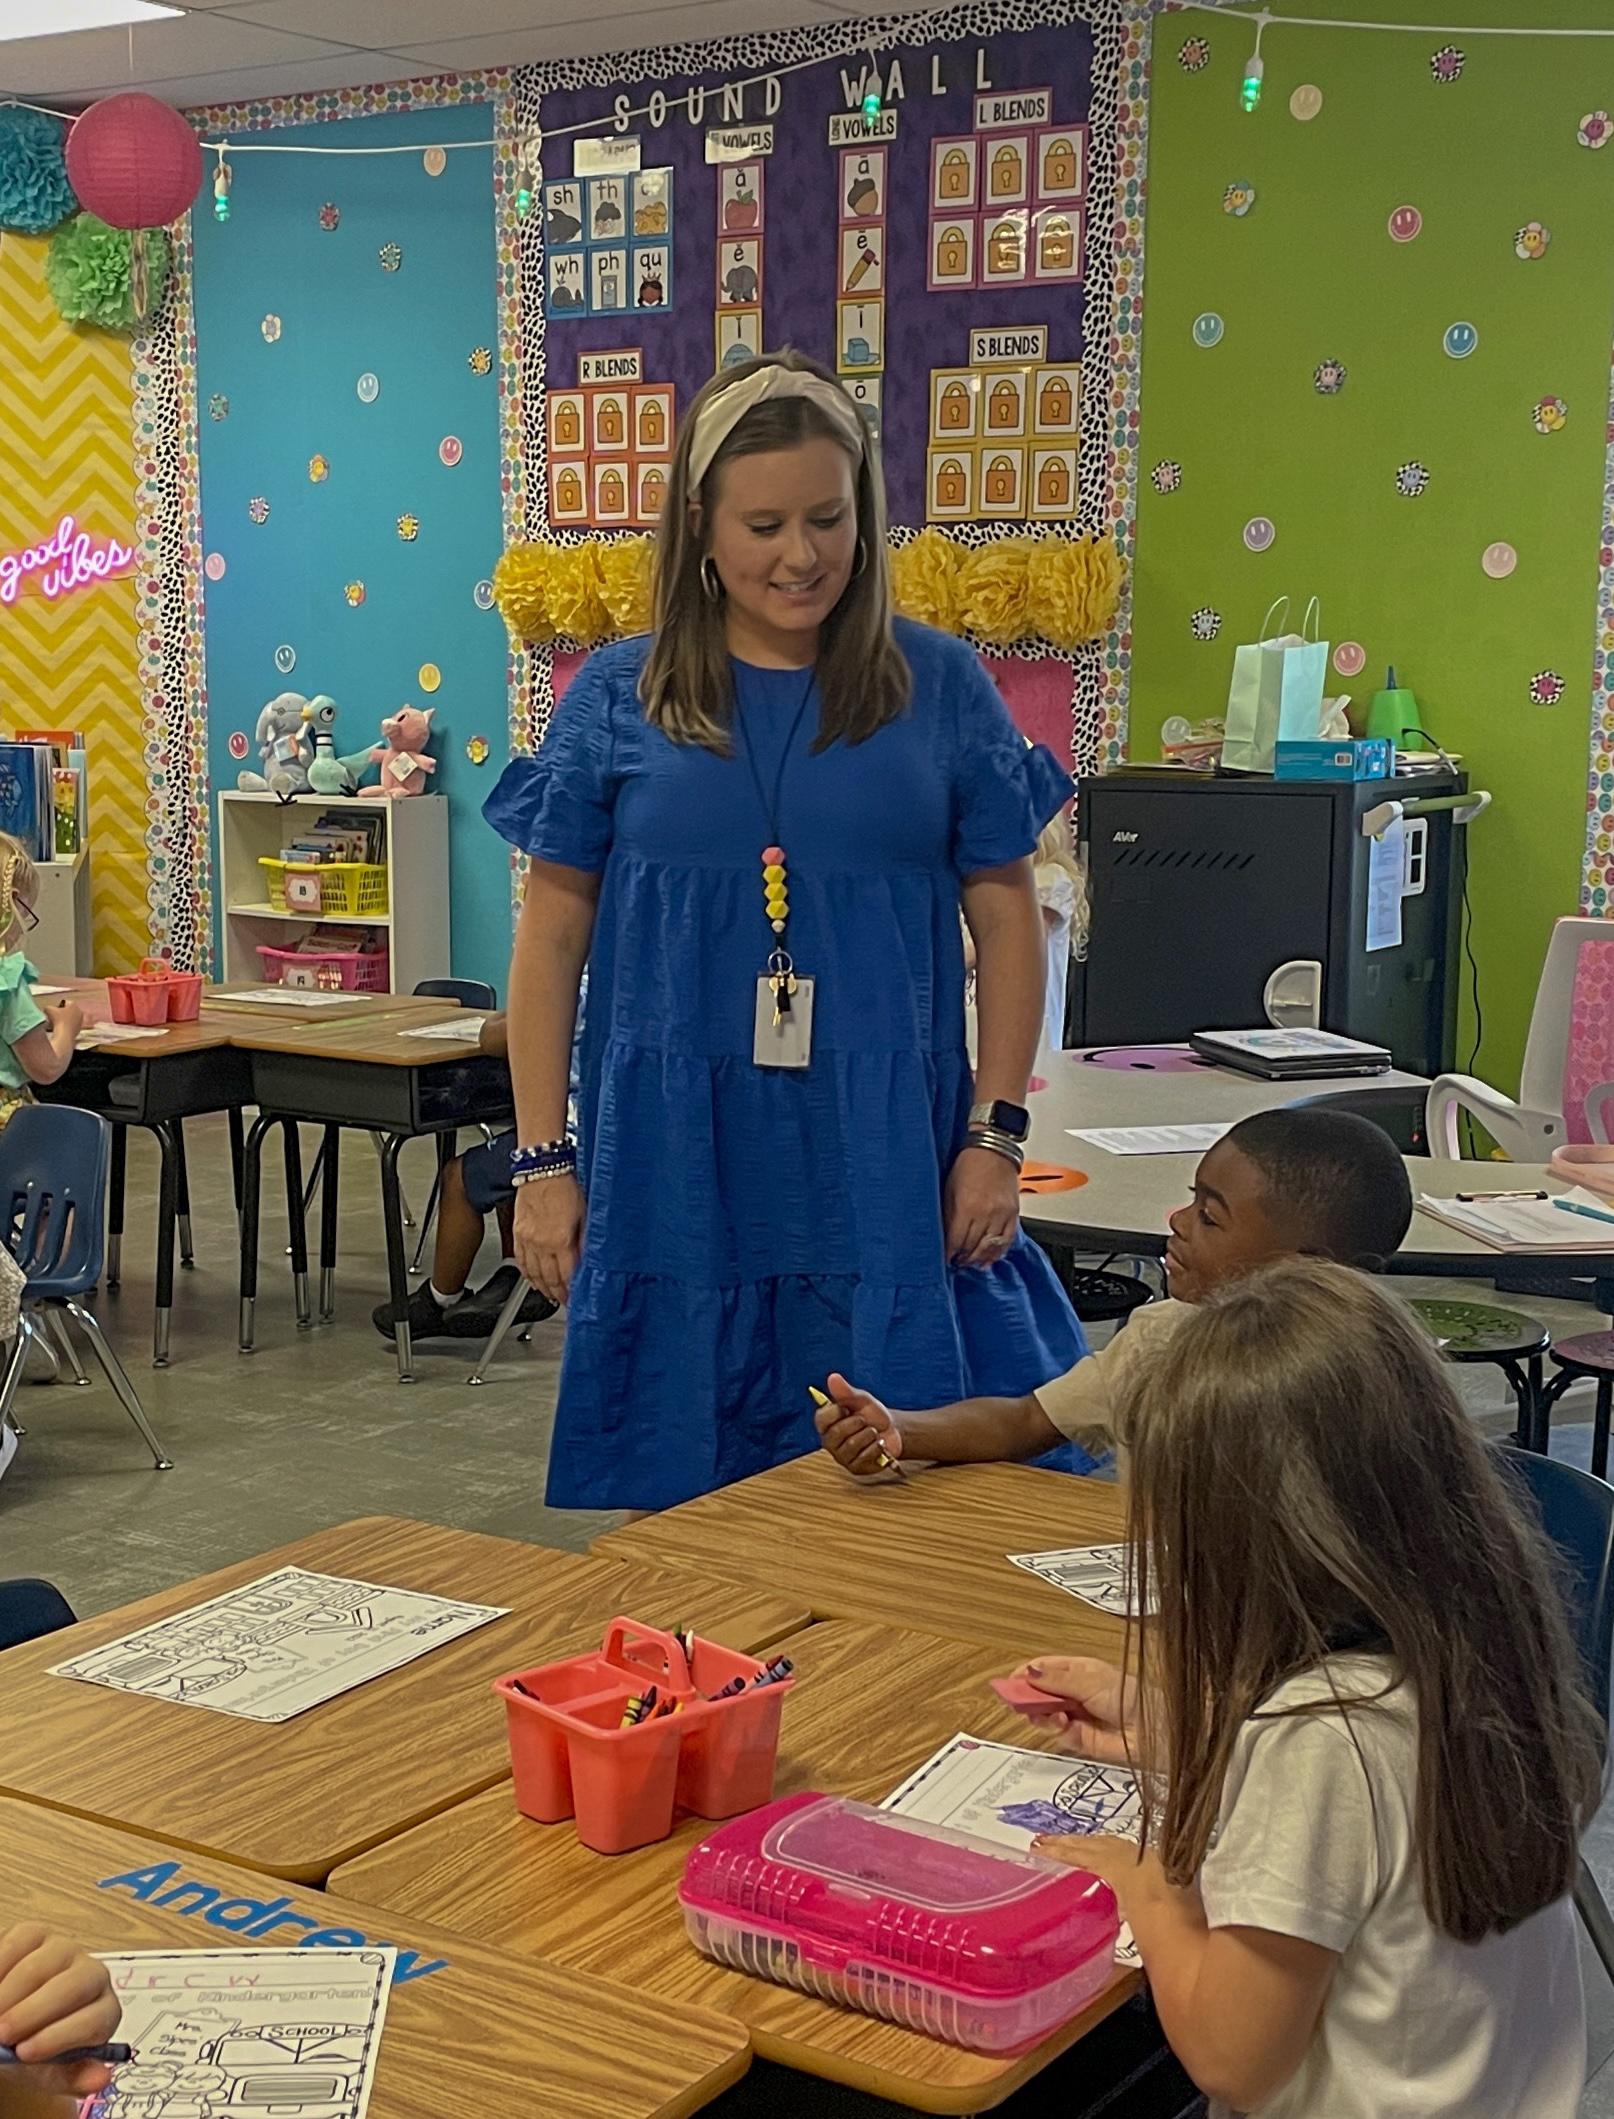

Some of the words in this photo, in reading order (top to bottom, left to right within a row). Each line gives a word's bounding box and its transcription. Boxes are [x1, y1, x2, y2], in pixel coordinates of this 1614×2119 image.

[613, 77, 781, 131] SOUND
[840, 49, 992, 108] WALL
[980, 104, 987, 123] L
[993, 98, 1045, 122] BLENDS
[843, 115, 894, 139] VOWELS
[553, 186, 573, 205] sh
[597, 180, 617, 199] th
[555, 256, 579, 274] wh
[598, 252, 619, 278] ph
[640, 252, 662, 270] qu
[977, 339, 986, 357] S
[989, 336, 1040, 355] BLENDS
[583, 361, 590, 378] R
[595, 358, 637, 377] BLENDS
[0, 515, 75, 602] good
[43, 533, 132, 597] vibes
[97, 1861, 448, 1984] Andrew
[268, 2026, 346, 2037] SCHOOL
